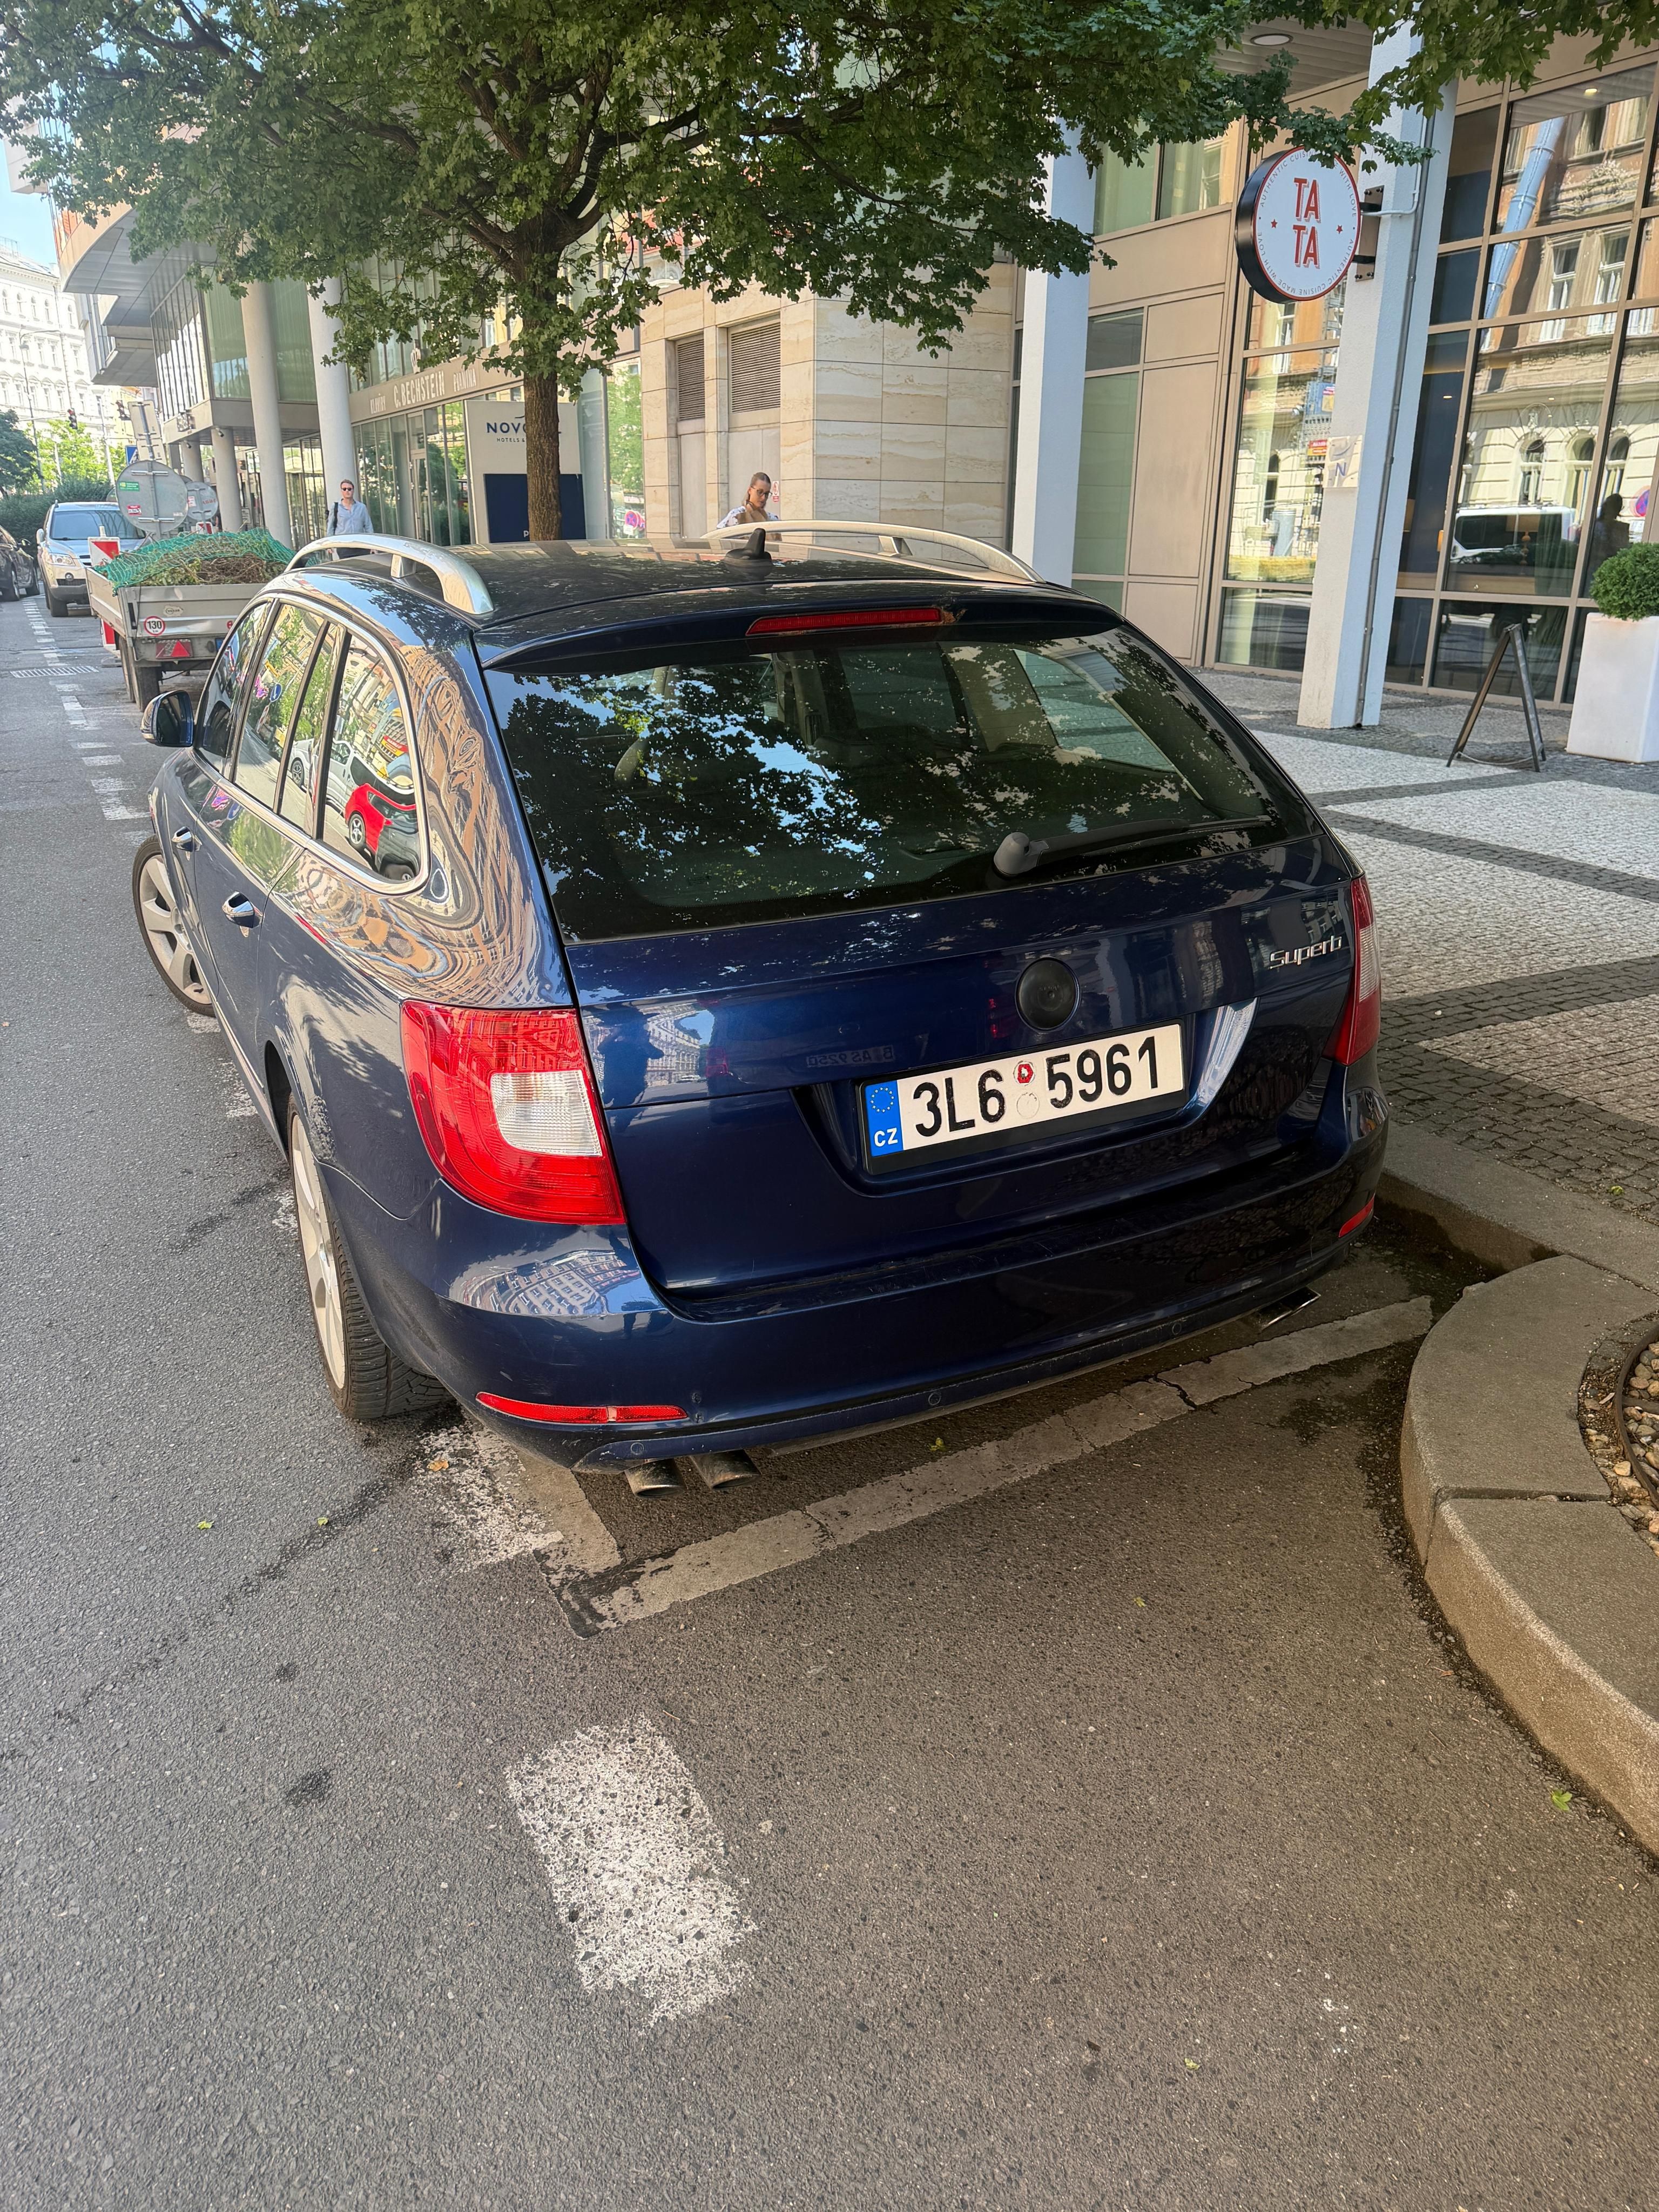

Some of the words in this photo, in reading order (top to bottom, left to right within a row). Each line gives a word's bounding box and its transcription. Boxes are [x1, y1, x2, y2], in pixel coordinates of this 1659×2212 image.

[1260, 160, 1288, 207] AUTHENTIC
[1290, 150, 1314, 162] CUISIN
[1339, 168, 1351, 190] WITH
[1349, 193, 1357, 217] LOVE
[1293, 177, 1321, 223] TA
[1257, 231, 1266, 256] LOVE
[1292, 224, 1320, 269] TA
[1264, 259, 1277, 279] WITH
[1327, 239, 1354, 285] AUTHENTIC
[1278, 279, 1296, 294] MADE
[1299, 283, 1326, 295] CUISINE
[401, 370, 445, 406] BECHSTEIN
[454, 368, 476, 392] PIANINA
[147, 621, 162, 629] 130
[1270, 935, 1342, 969] Superb
[913, 1069, 1006, 1137] 3L6
[1046, 1036, 1158, 1109] 5961
[874, 1128, 898, 1148] CZ
